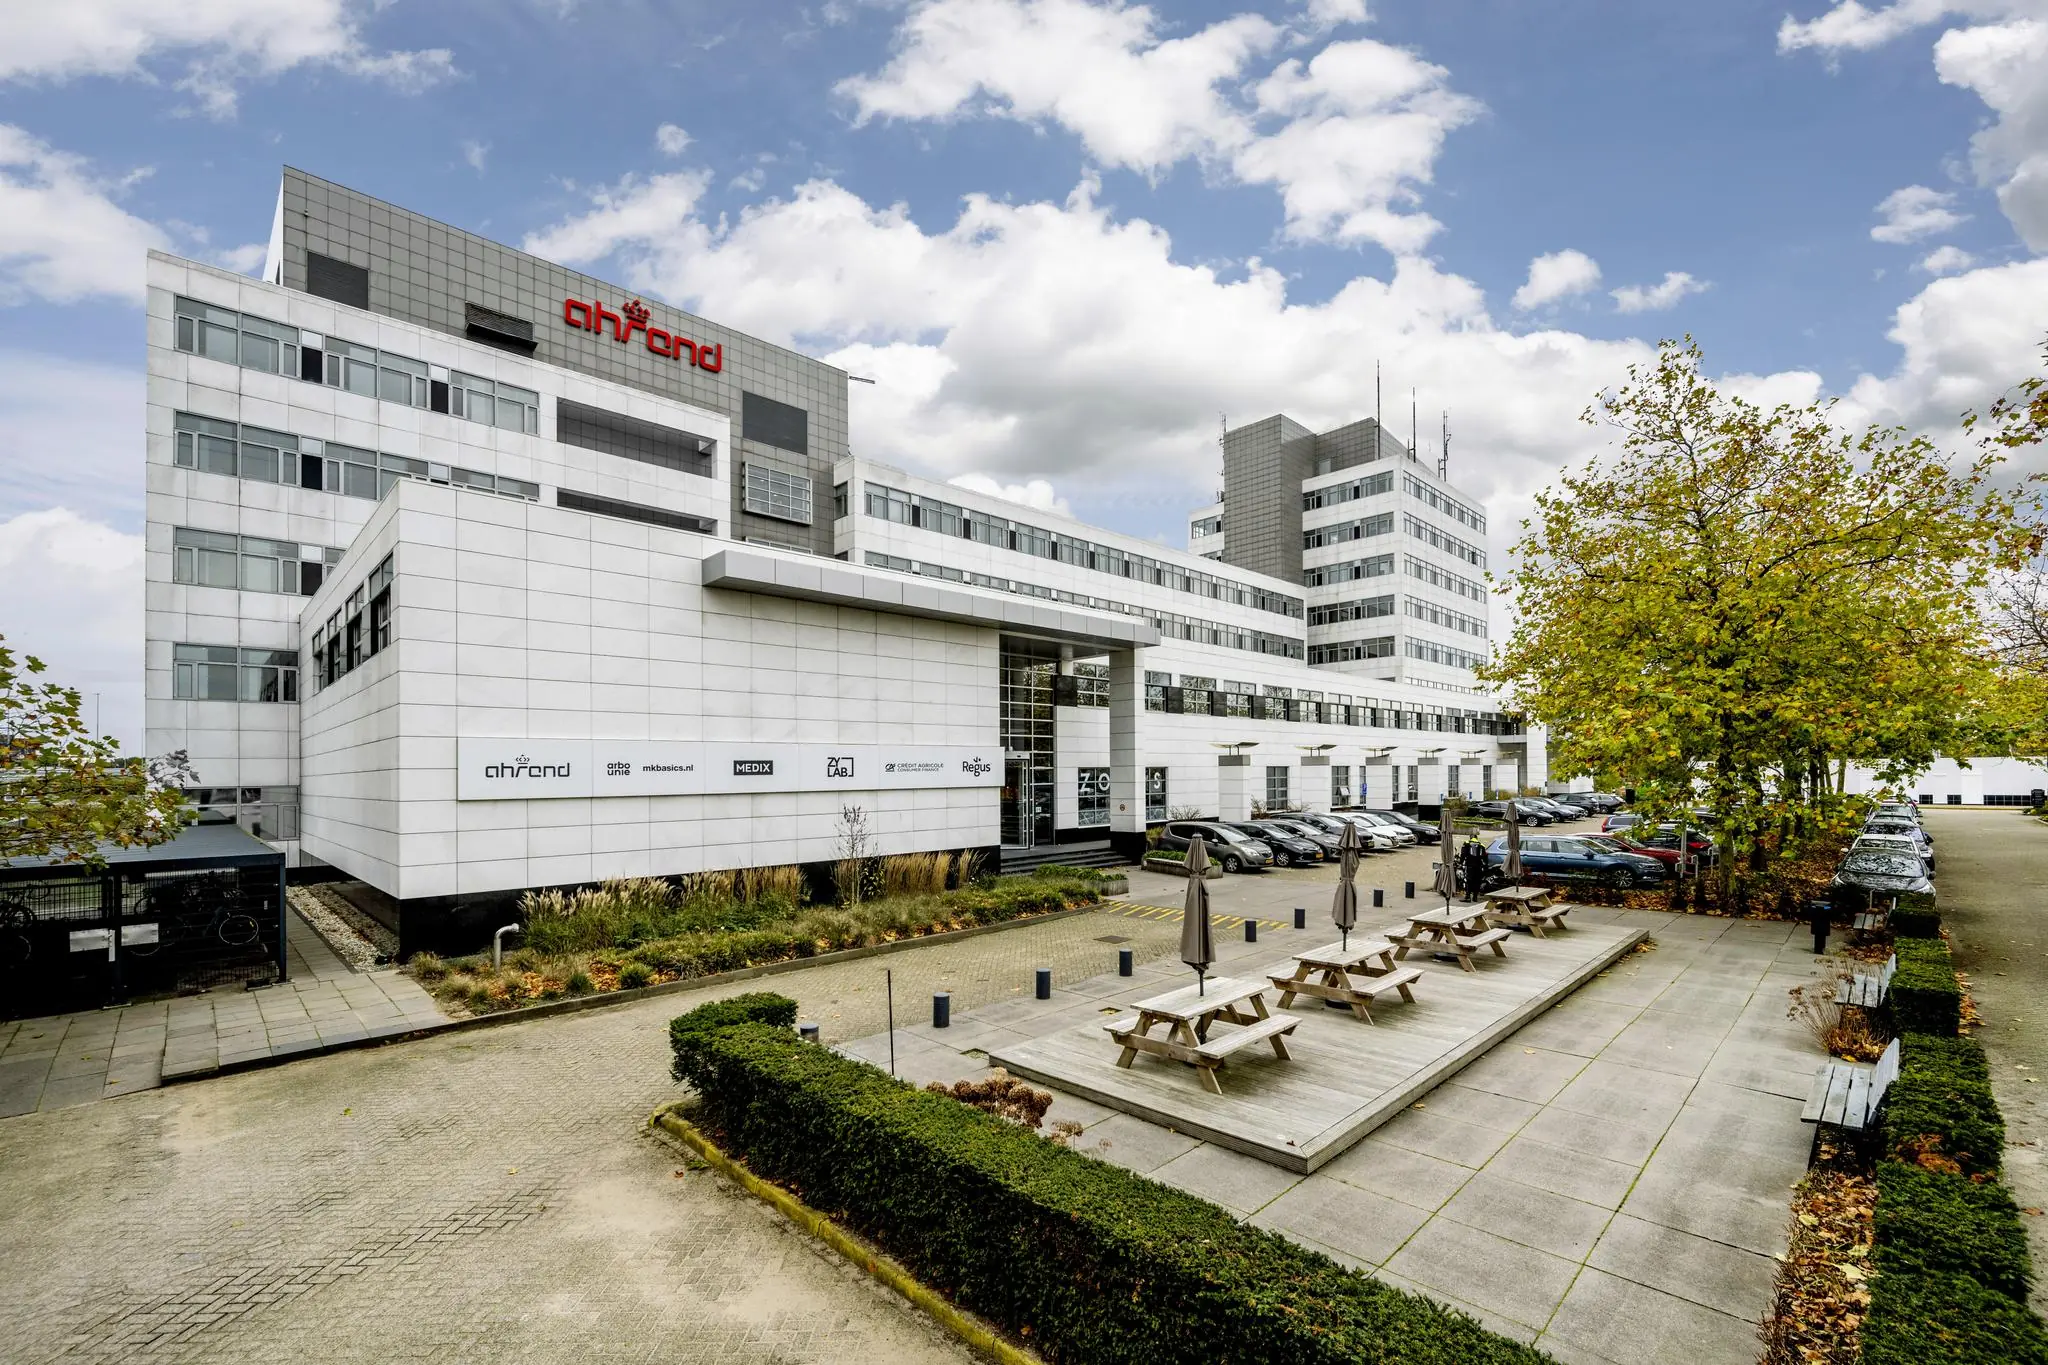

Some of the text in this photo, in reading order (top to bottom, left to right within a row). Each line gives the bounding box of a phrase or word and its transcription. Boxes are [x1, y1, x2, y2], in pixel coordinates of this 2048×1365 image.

[564, 298, 723, 374] ahrend
[485, 762, 570, 778] ahrend
[607, 761, 631, 769] arbo
[642, 764, 694, 772] mkbasics.nl
[736, 763, 770, 773] MEDIX
[962, 761, 991, 777] Regus
[827, 767, 848, 777] LAB
